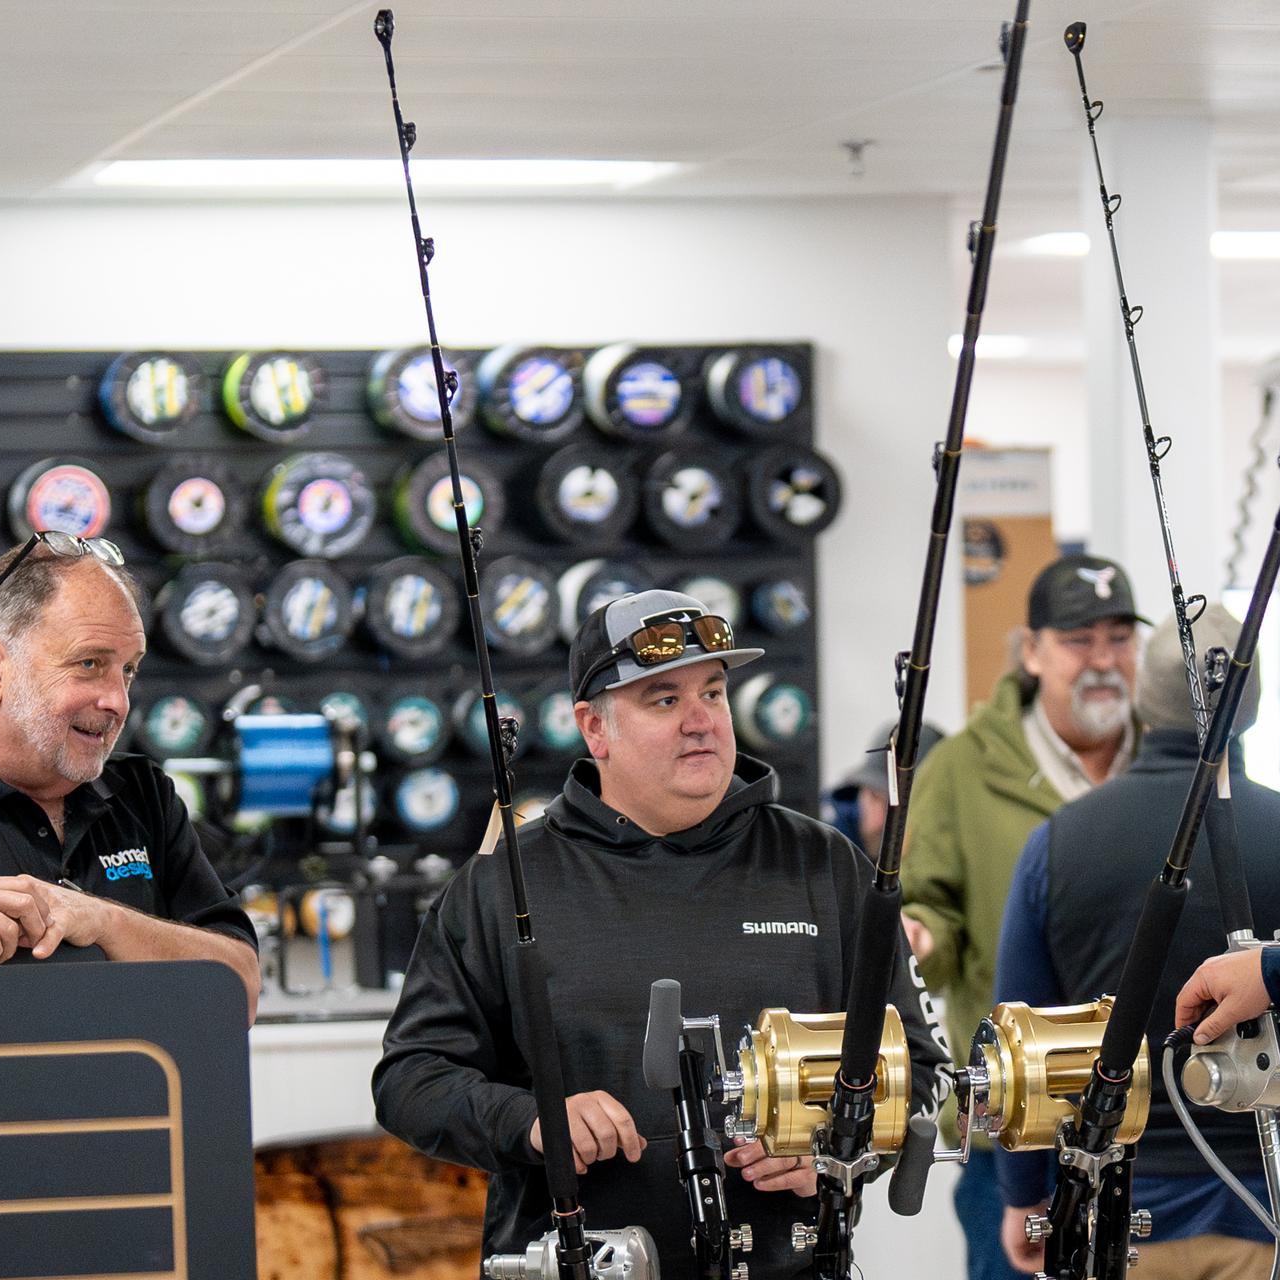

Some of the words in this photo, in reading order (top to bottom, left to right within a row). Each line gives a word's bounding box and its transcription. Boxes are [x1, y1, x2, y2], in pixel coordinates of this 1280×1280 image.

[99, 845, 150, 869] nomad
[106, 861, 153, 881] desig
[742, 921, 819, 937] SHIMANO
